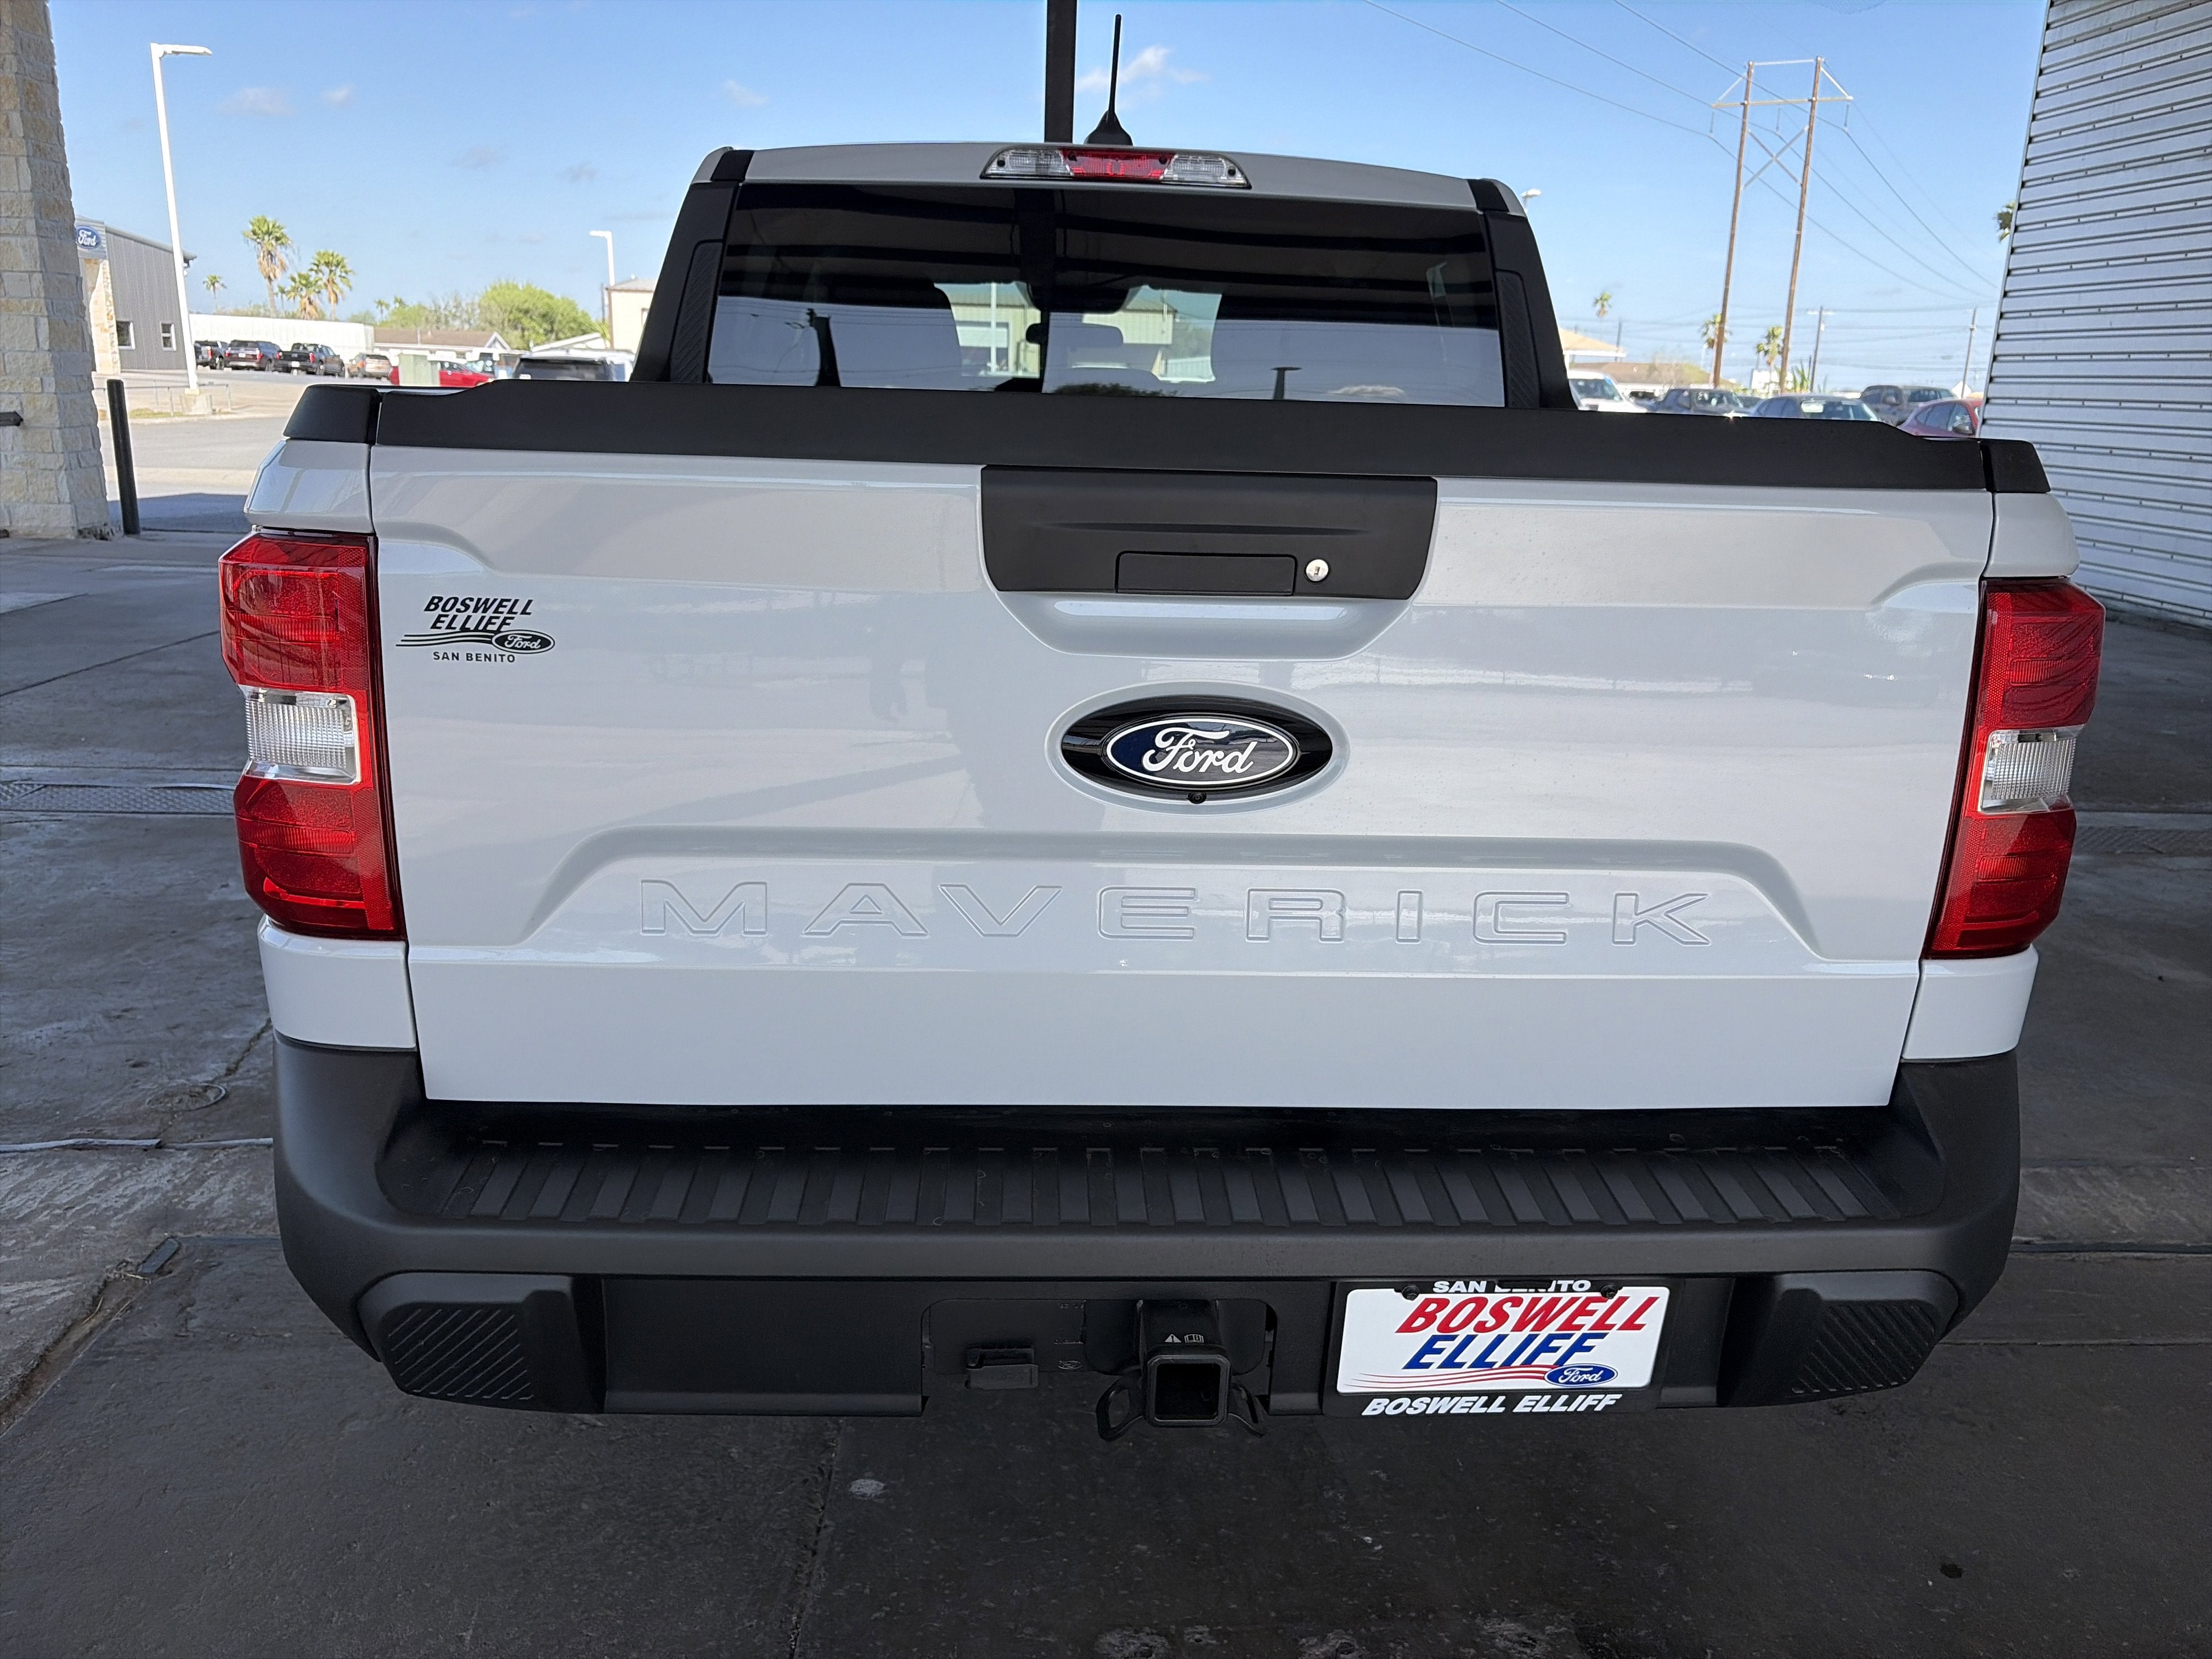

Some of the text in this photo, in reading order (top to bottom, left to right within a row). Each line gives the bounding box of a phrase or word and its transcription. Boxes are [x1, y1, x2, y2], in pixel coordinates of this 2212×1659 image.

[78, 229, 97, 246] Ford
[424, 596, 533, 615] BOSWELL
[430, 614, 515, 631] ELLIFF
[504, 634, 541, 649] Ford
[433, 651, 515, 663] SAN BENITO
[1141, 727, 1258, 774] Ford
[640, 879, 1712, 946] MAVERICK
[1432, 1281, 1487, 1293] SAN
[1395, 1296, 1660, 1333] BOSWELL
[1402, 1333, 1609, 1369] ELLIFF
[1558, 1367, 1602, 1384] Ford
[1362, 1393, 1623, 1416] BOSWELL ELLIFF
